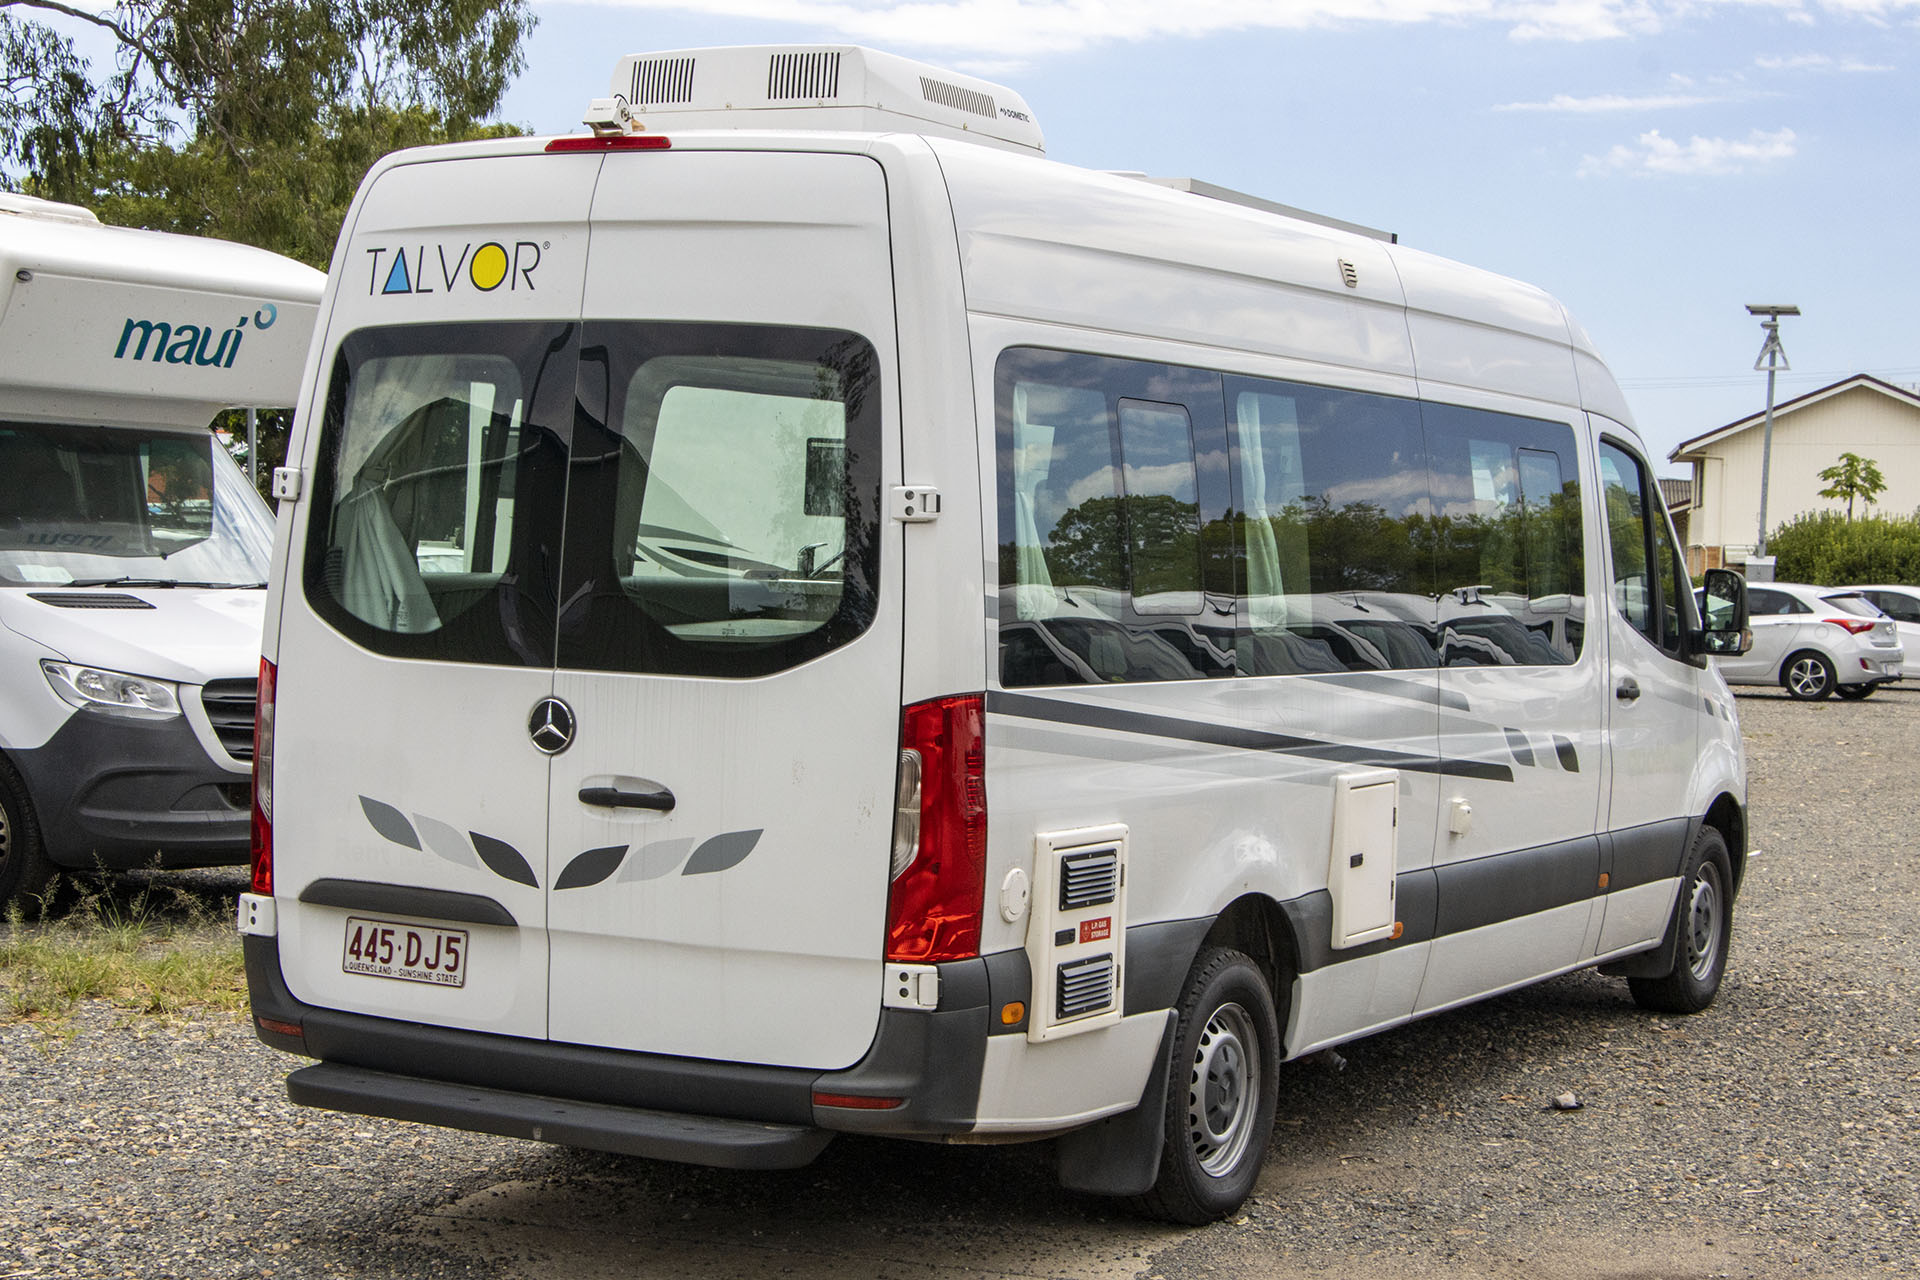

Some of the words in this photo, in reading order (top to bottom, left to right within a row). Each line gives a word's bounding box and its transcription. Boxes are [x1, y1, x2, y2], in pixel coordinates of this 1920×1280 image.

[367, 241, 541, 296] TALVOR
[113, 316, 249, 369] maui
[349, 962, 392, 975] QUEENSLAND
[398, 968, 433, 981] SUNSHINE
[436, 974, 458, 984] STATE
